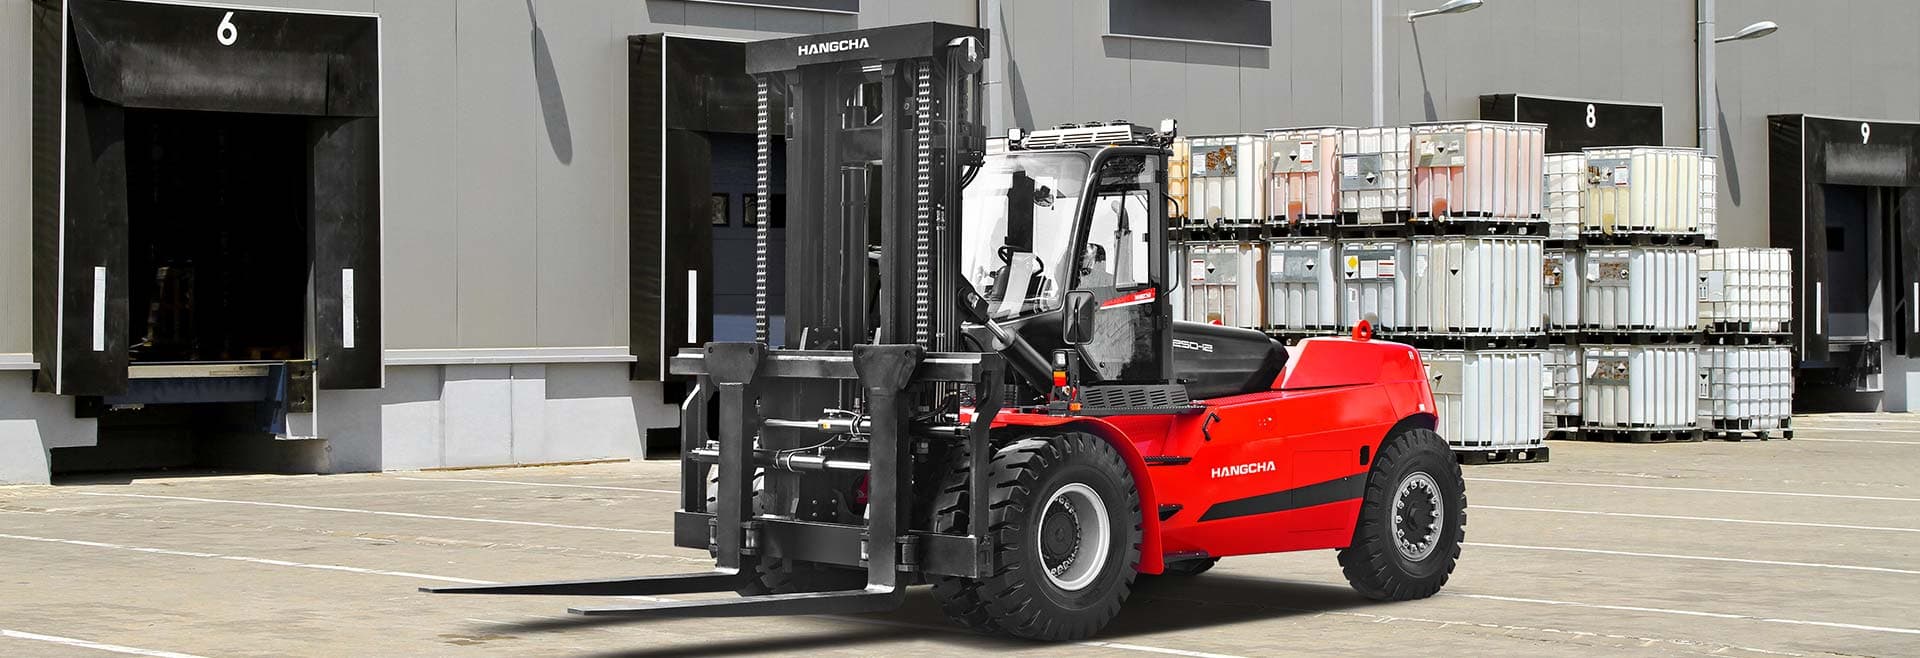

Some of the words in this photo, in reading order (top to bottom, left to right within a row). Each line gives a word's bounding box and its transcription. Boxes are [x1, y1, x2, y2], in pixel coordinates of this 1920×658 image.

[217, 11, 238, 46] 6
[798, 37, 870, 57] HANGCHA
[1586, 103, 1597, 129] 8
[1860, 122, 1871, 145] 9
[1211, 460, 1276, 478] HANGCHA
